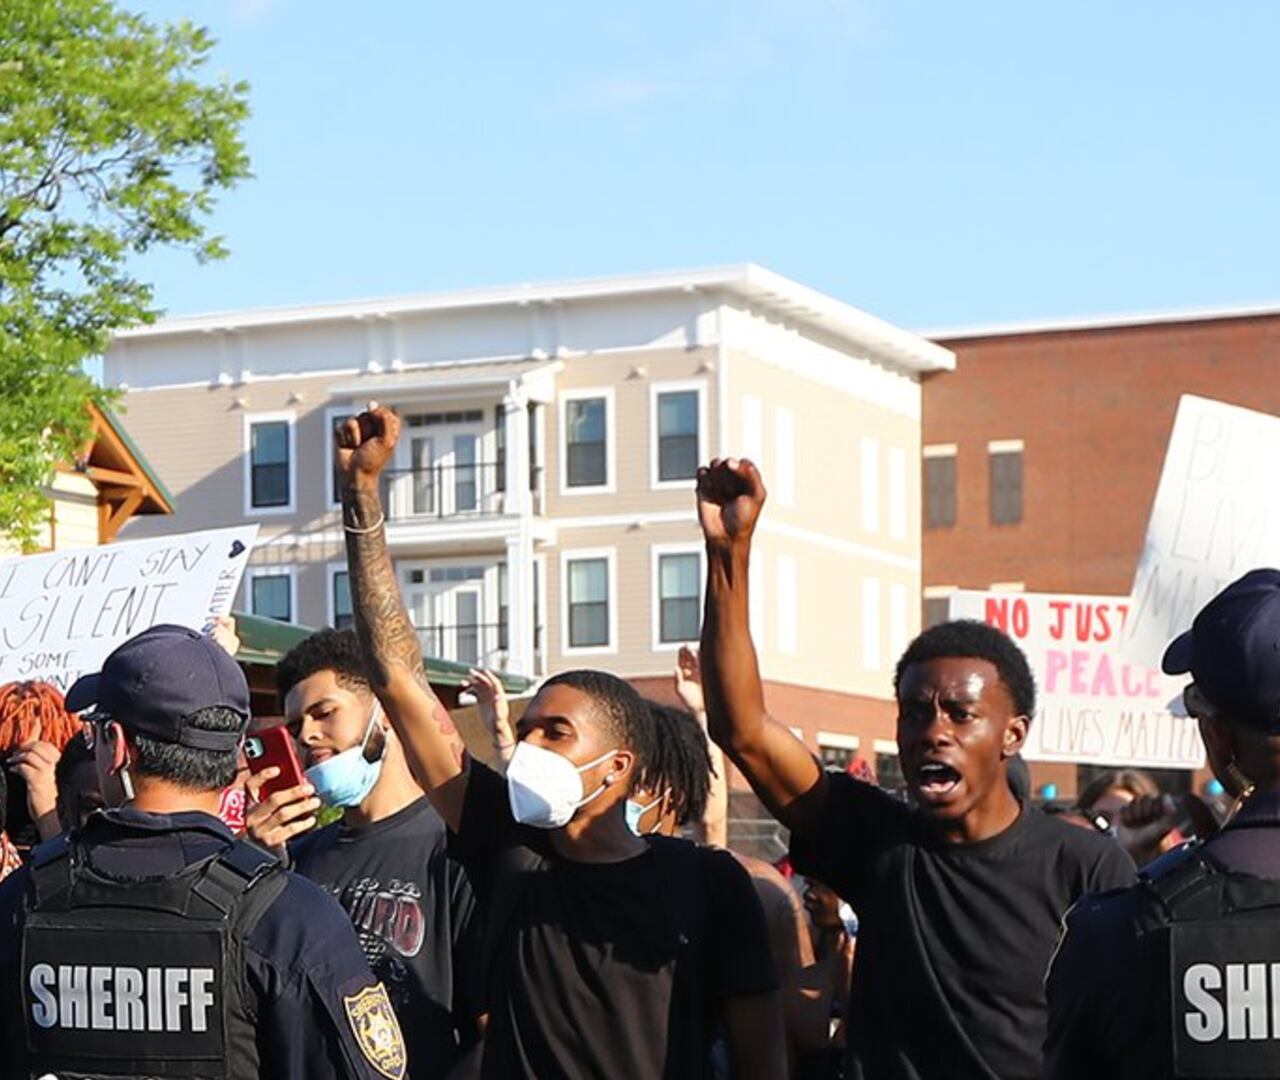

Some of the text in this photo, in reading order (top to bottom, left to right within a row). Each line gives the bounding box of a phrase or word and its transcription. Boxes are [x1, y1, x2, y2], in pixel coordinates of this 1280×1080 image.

[139, 543, 211, 577] STAY
[3, 582, 178, 650] SILENT
[984, 598, 1030, 639] NO
[18, 650, 76, 675] SOME
[1044, 650, 1161, 697] PEACE
[1038, 707, 1106, 757] LIVES
[30, 963, 214, 1033] SHERIFF
